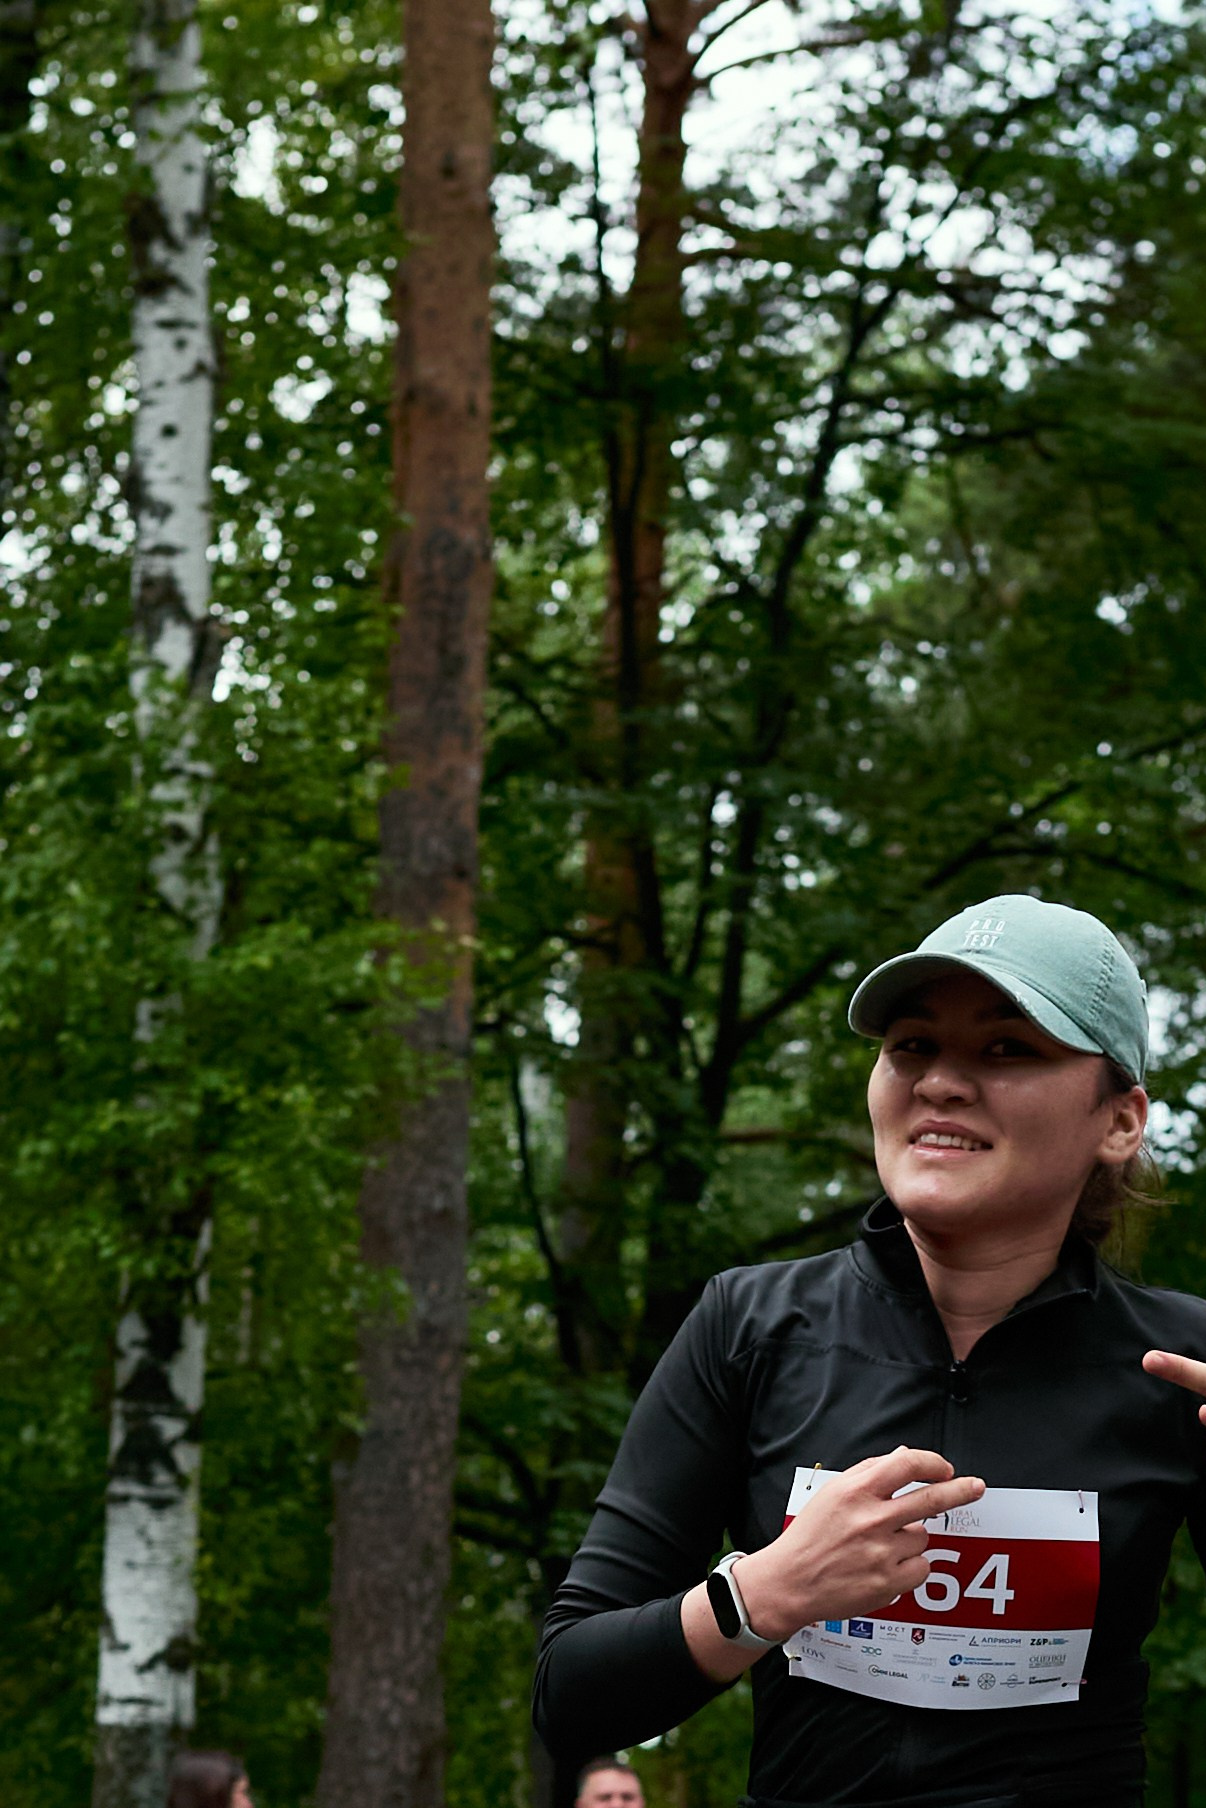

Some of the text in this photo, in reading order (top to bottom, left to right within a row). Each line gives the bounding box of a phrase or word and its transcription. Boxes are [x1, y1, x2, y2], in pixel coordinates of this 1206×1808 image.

[969, 918, 1006, 932] PRO
[963, 933, 999, 948] TEST
[950, 1516, 981, 1527] LEGAL
[889, 1548, 1015, 1615] 64
